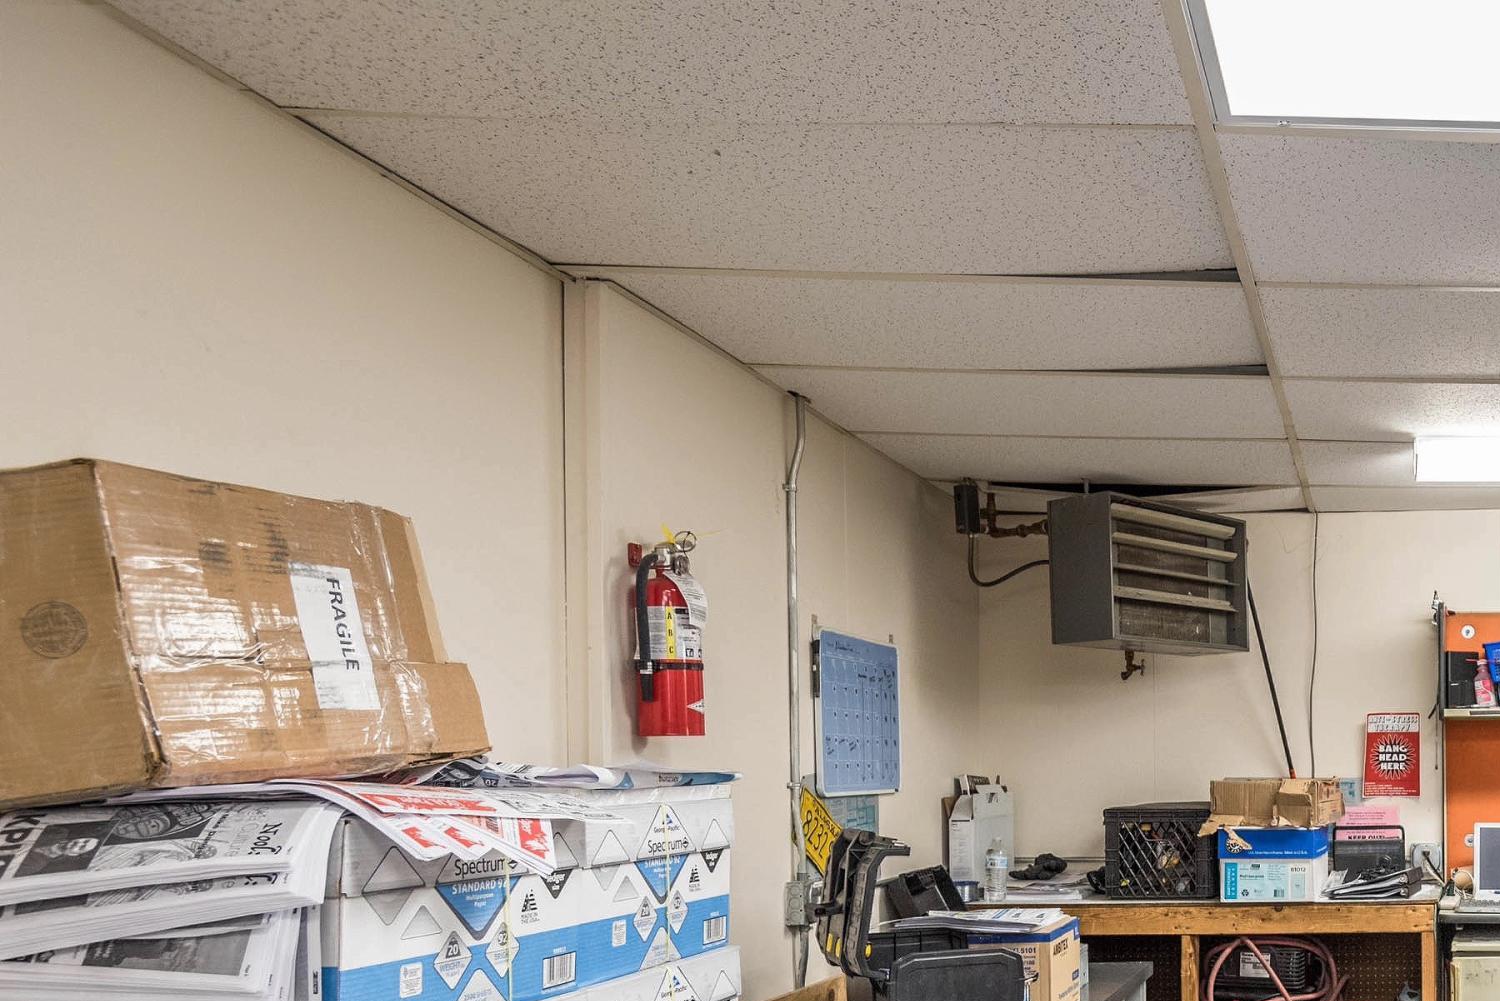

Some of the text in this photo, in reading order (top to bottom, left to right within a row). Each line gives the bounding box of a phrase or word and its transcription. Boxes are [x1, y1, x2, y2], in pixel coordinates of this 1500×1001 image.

[667, 612, 672, 620] A
[327, 578, 359, 670] FRAGILE
[668, 629, 673, 637] B
[669, 646, 674, 654] C
[1379, 744, 1407, 753] BANG
[1380, 762, 1405, 770] HERE
[452, 878, 496, 895] STANDARD
[449, 944, 459, 955] 20
